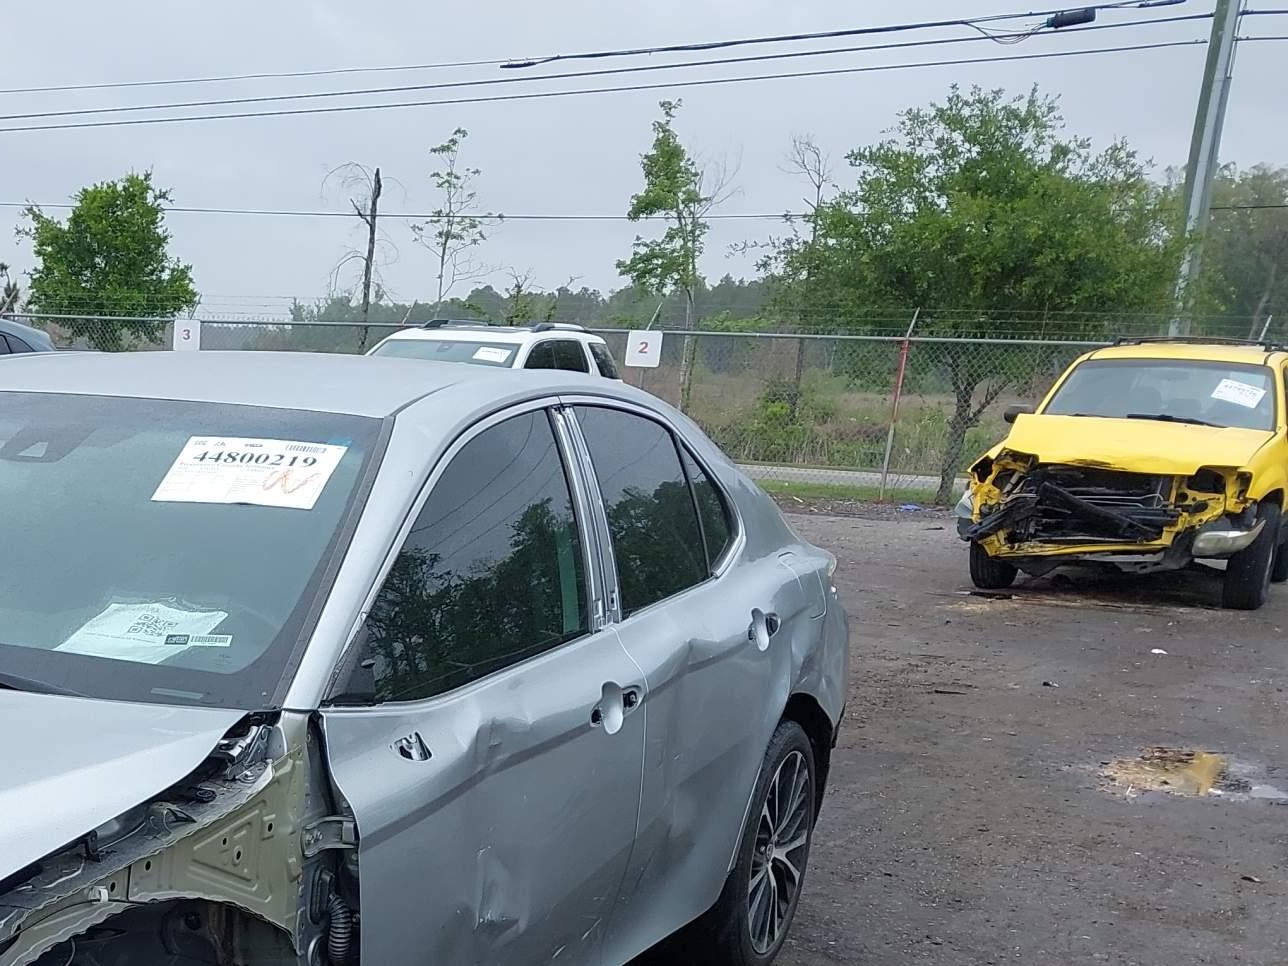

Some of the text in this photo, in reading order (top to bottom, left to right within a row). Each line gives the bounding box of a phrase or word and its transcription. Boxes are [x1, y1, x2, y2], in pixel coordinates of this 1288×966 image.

[183, 329, 191, 341] 3
[638, 341, 649, 353] 2
[193, 450, 318, 468] 44800219
